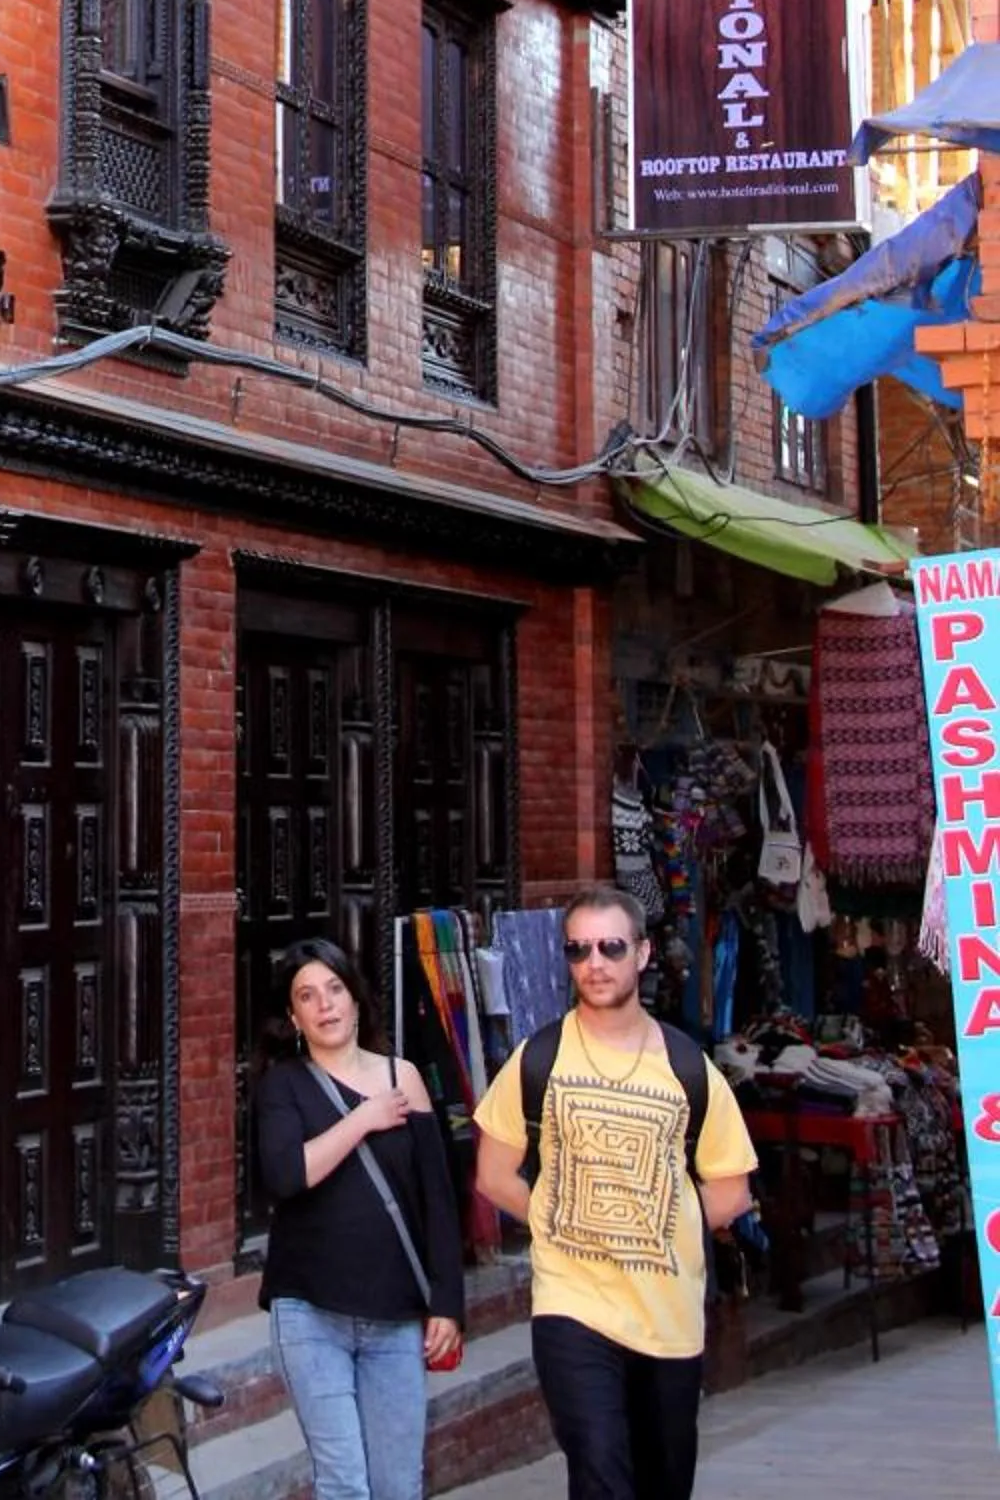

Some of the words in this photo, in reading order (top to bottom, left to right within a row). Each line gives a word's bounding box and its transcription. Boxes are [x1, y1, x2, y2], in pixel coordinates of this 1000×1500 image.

[735, 131, 750, 149] &
[641, 156, 720, 177] ROOFTOP
[726, 150, 847, 174] RESTAURANT
[687, 182, 839, 199] www.hoteltraditional.com
[919, 560, 1000, 606] NAM
